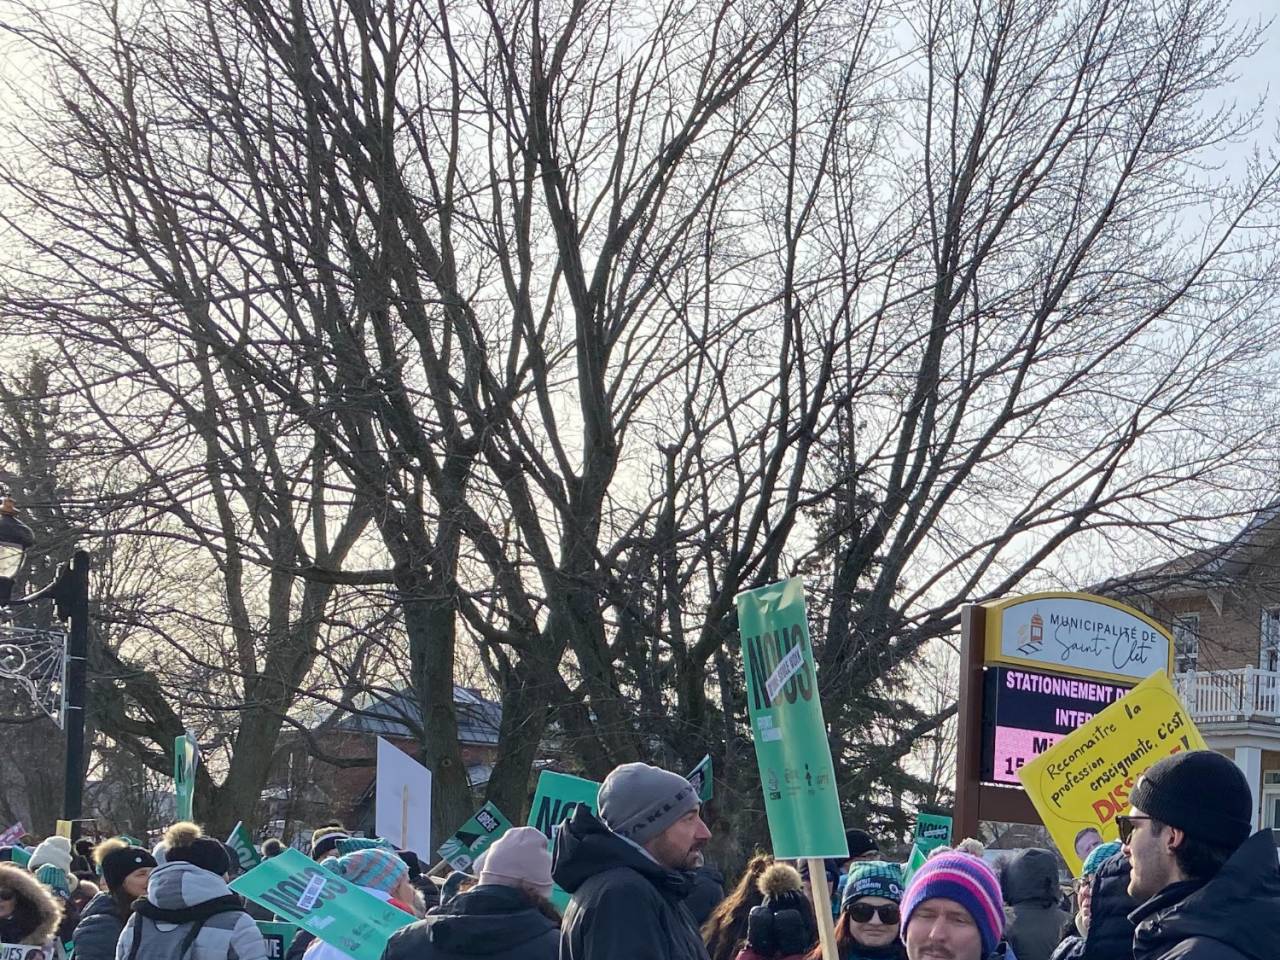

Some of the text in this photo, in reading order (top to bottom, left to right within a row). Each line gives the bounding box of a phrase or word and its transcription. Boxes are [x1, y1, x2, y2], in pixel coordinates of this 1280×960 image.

[1050, 613, 1157, 643] MUNICIPALITÉ DE
[1006, 670, 1114, 703] STATIONNEMENT
[1124, 703, 1142, 720] la
[1050, 757, 1105, 809] profession
